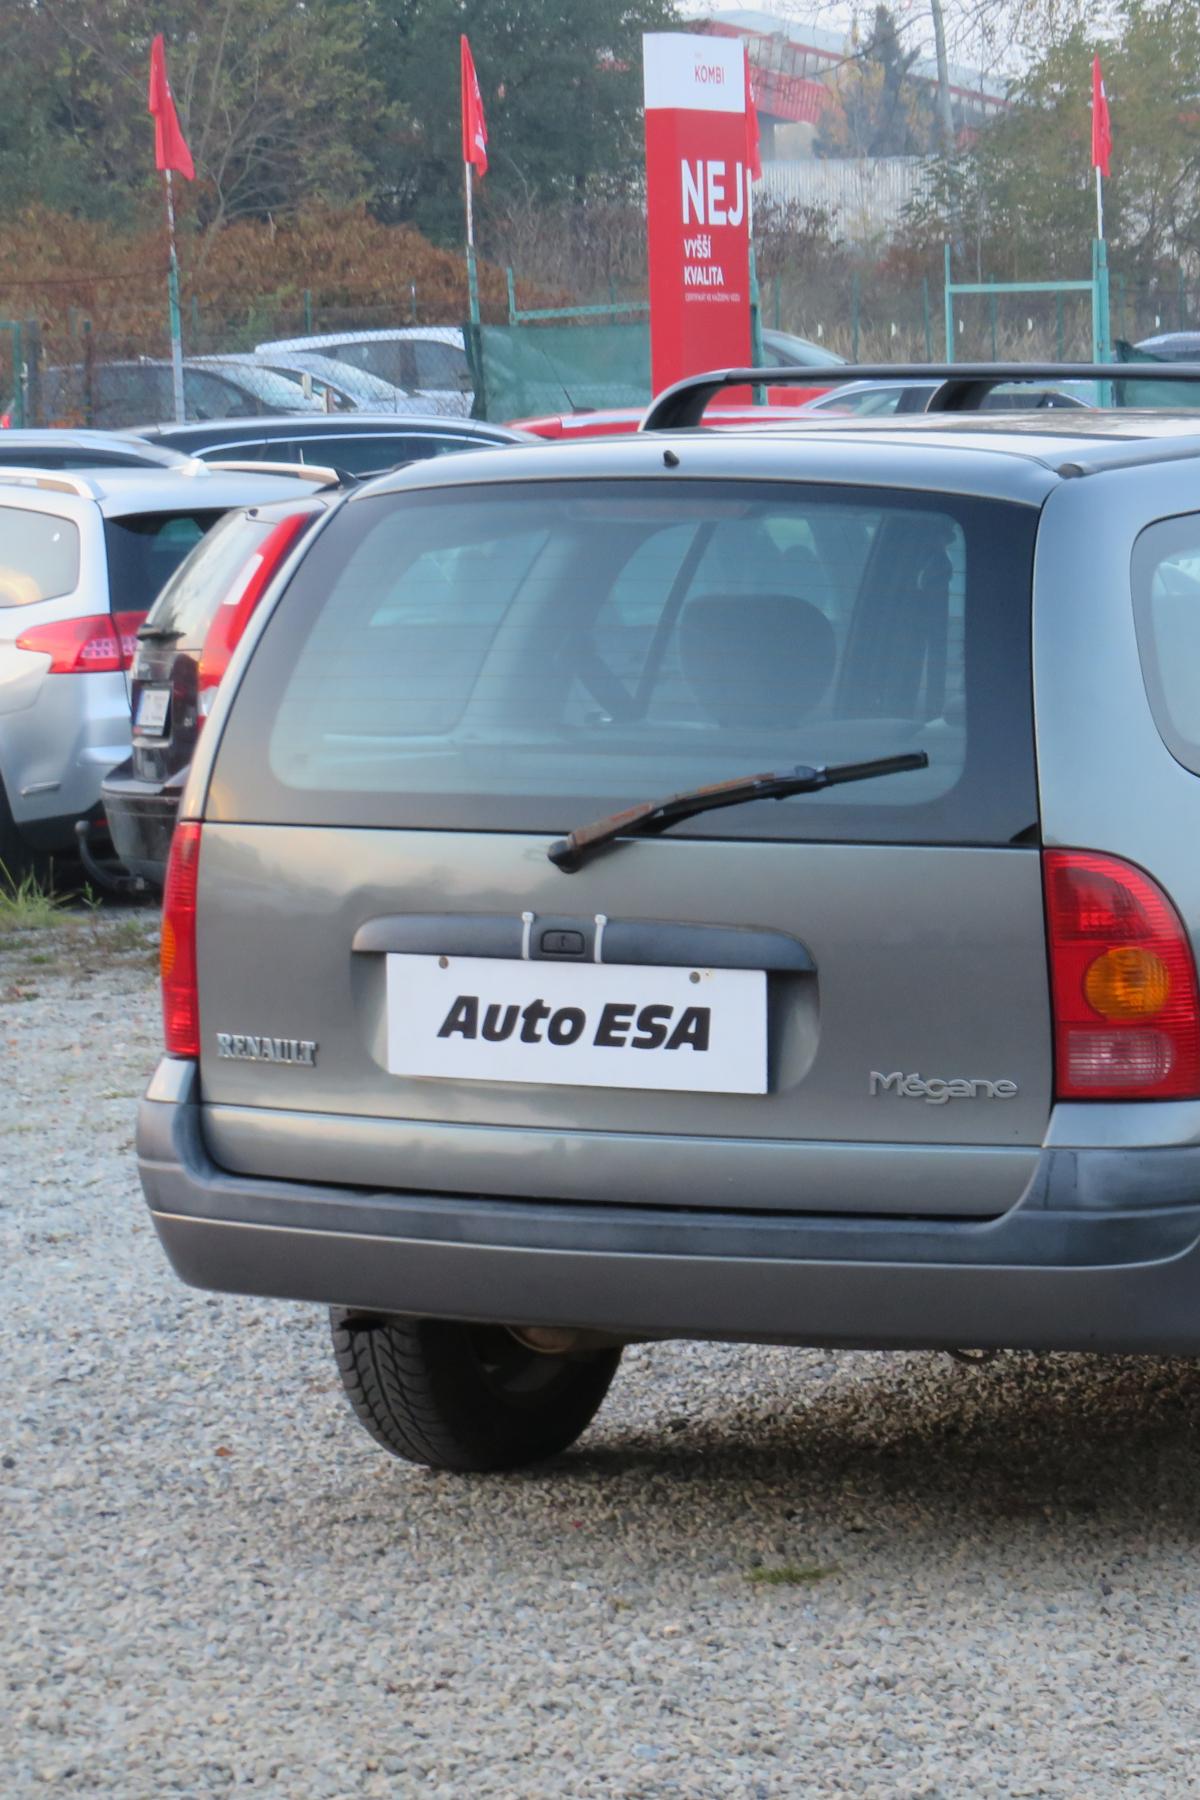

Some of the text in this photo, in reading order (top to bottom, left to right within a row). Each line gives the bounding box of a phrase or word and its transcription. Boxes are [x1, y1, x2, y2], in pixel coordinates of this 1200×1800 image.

[694, 64, 725, 85] KOMBI
[681, 159, 743, 226] NEJ
[684, 234, 711, 258] VYŠŠÍ
[684, 266, 724, 286] KVALITA
[437, 995, 711, 1051] Auto ESA
[216, 1033, 316, 1065] RENAULT
[869, 1071, 1018, 1105] Mégane
